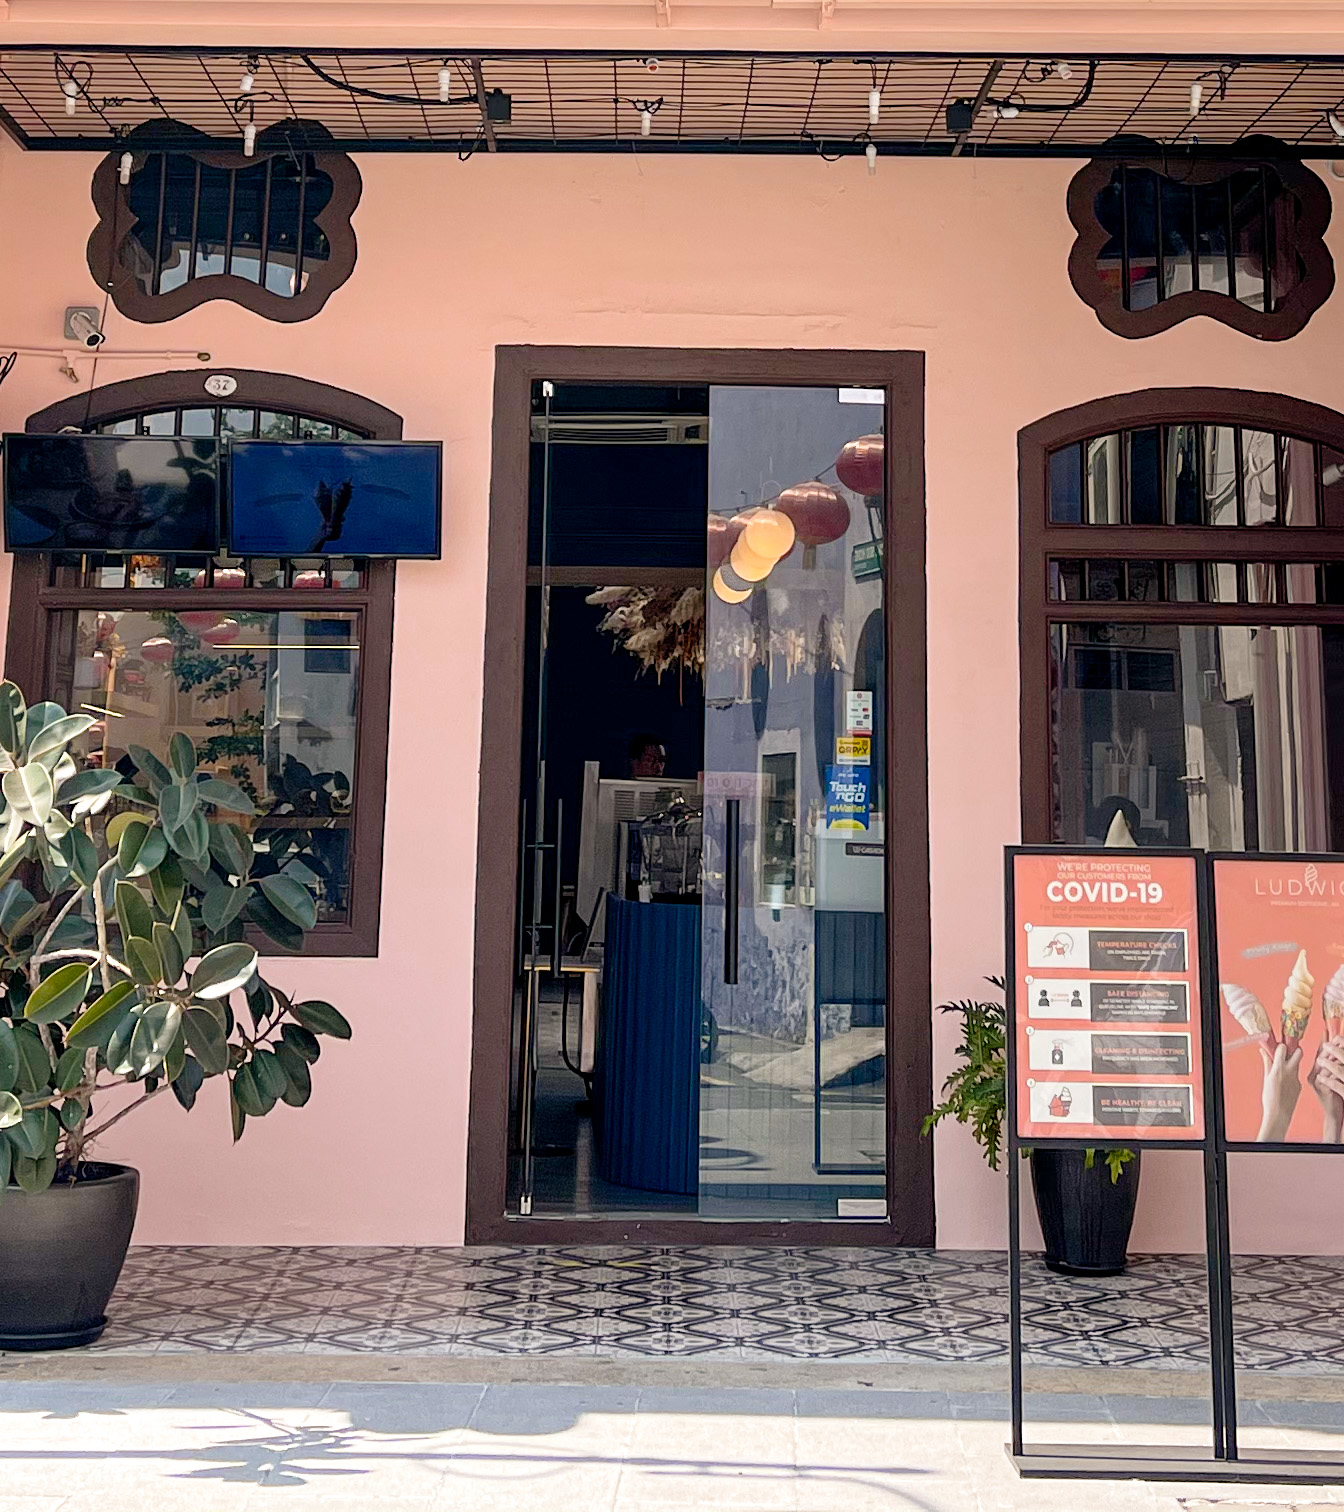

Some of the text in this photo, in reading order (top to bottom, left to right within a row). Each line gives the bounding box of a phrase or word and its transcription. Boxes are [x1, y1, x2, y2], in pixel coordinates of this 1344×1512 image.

[212, 379, 231, 391] 37
[829, 781, 866, 792] Touch
[829, 804, 865, 813] eWallet
[1057, 862, 1152, 873] WE'RE PROTECTING
[1057, 872, 1152, 881] OUR CUSTOMERS FROM
[1046, 880, 1163, 904] COVID-19
